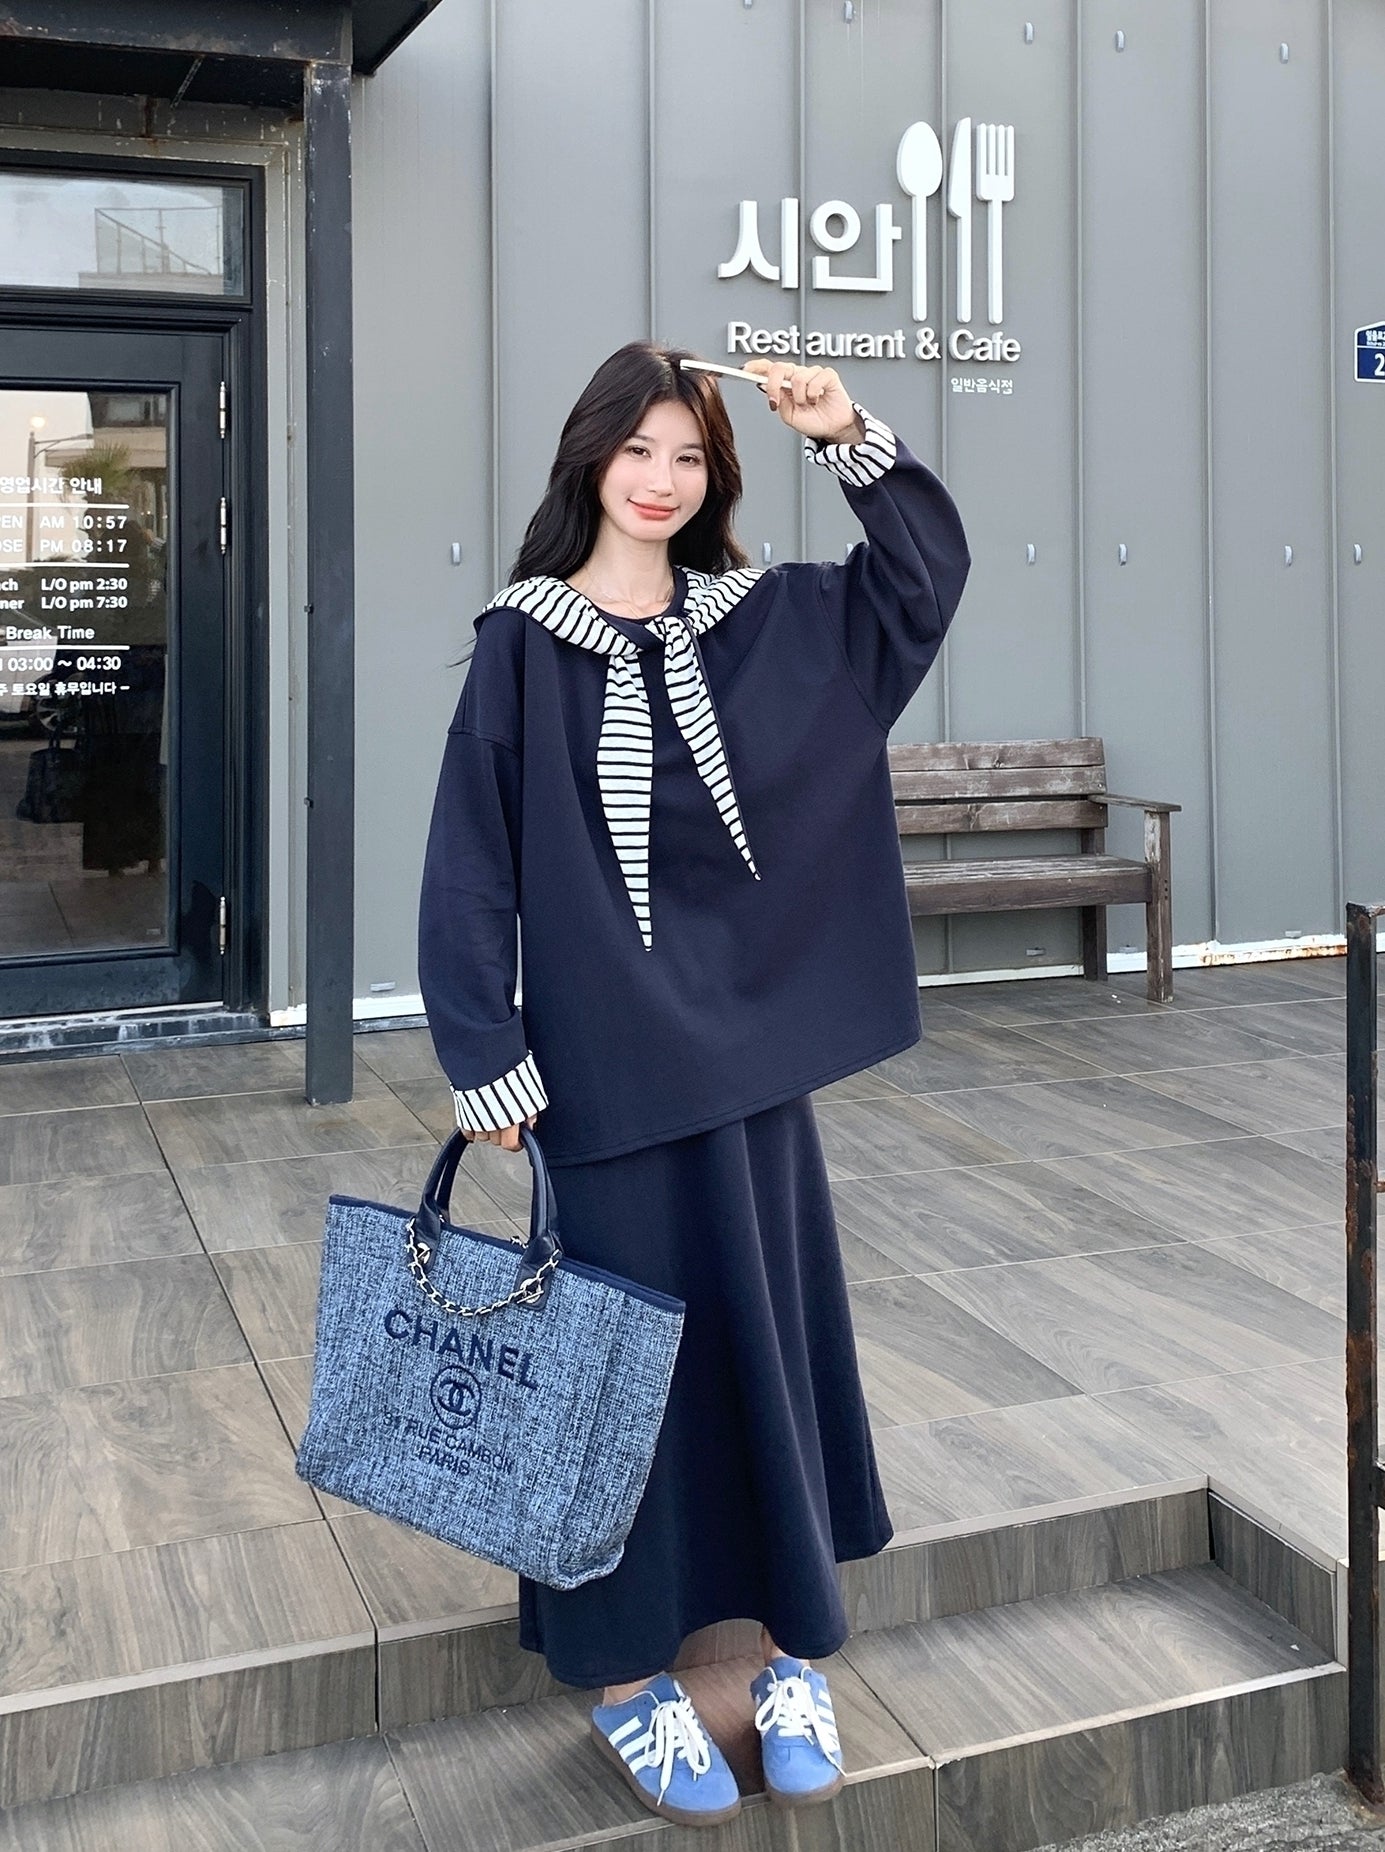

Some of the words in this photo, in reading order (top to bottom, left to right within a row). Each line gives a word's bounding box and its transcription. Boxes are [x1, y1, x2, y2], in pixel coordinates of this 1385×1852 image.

[718, 198, 902, 292] 시안
[728, 321, 906, 359] Restaurant
[915, 327, 942, 360] &
[951, 329, 1021, 362] Cafe
[951, 377, 1013, 395] 일반음식점
[0, 477, 65, 494] 영업시간
[70, 478, 102, 495] 안내
[0, 515, 23, 528] EN
[40, 516, 64, 529] AM
[74, 515, 127, 529] 10:57
[0, 539, 23, 552] SE
[40, 540, 64, 552] PM
[72, 539, 127, 552] 08:17
[0, 578, 18, 591] ch
[41, 578, 67, 591] L/O
[70, 580, 93, 593] pm
[96, 578, 128, 591] 2:30
[0, 600, 24, 609] ner
[41, 596, 67, 609] L/O
[70, 598, 93, 612] pm
[96, 596, 128, 608] 7:30
[6, 626, 52, 639] Break
[57, 625, 95, 639] Time
[8, 657, 53, 671] 03:00
[76, 656, 121, 670] 04:30
[11, 682, 51, 696] 토요일
[55, 681, 117, 696] 휴무입니다
[384, 1309, 538, 1391] CHANEL
